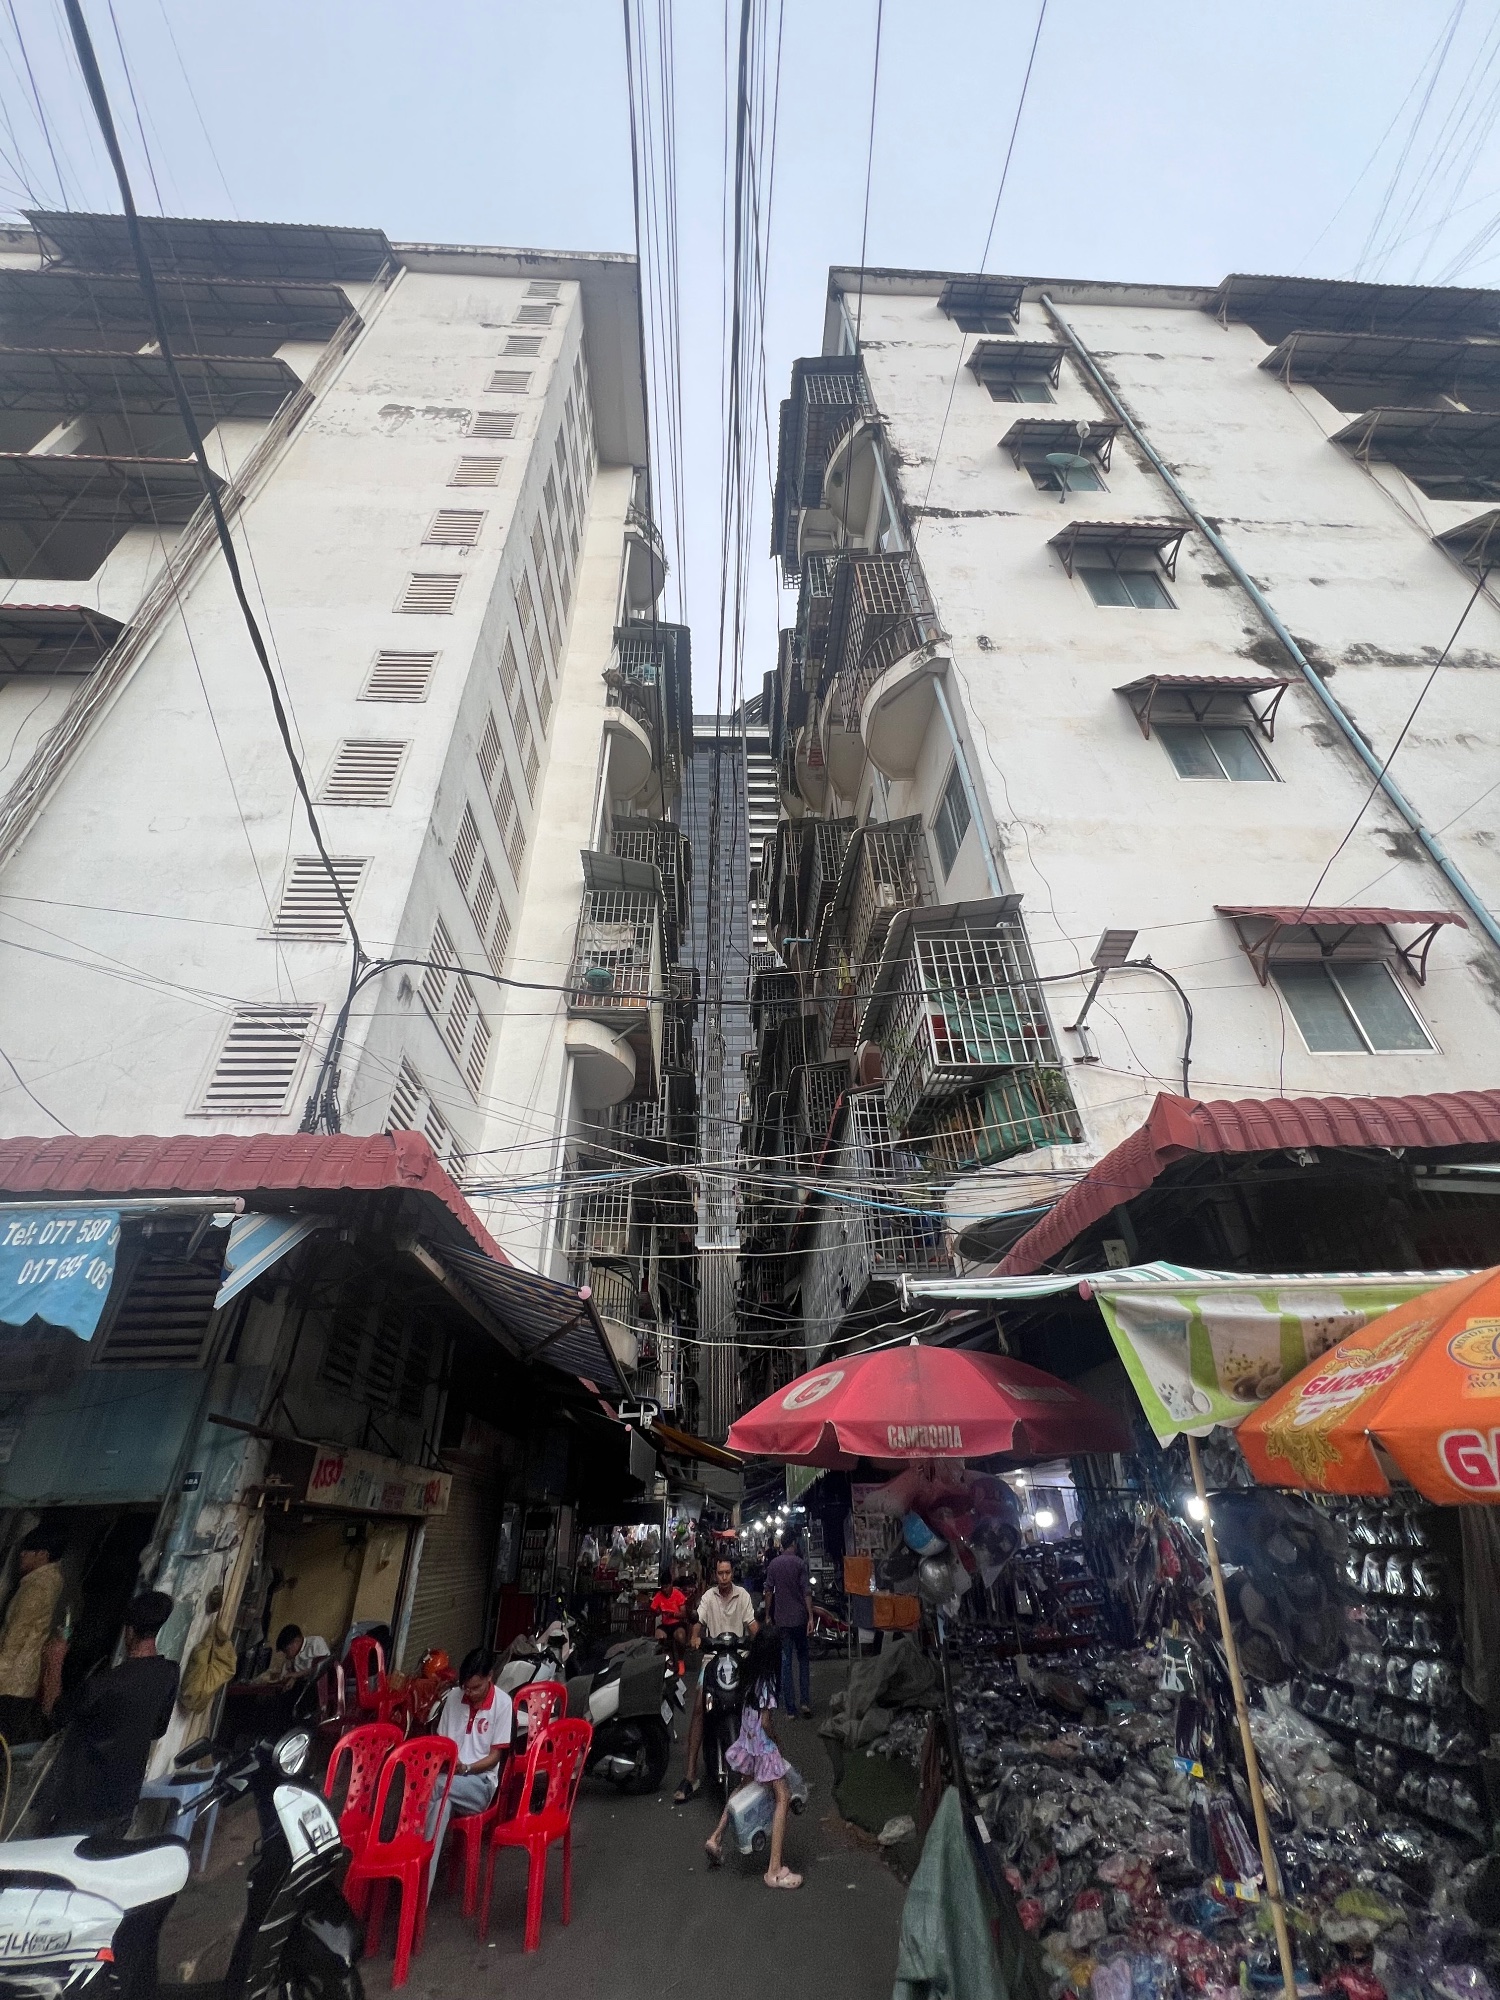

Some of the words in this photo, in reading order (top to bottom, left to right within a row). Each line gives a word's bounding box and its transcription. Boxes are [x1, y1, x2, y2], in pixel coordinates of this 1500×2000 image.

[1, 1222, 38, 1246] Tel:
[38, 1219, 78, 1245] 077
[76, 1218, 112, 1244] 580
[17, 1258, 59, 1285] 017
[85, 1256, 113, 1290] 105
[886, 1424, 963, 1450] CAMBODIA
[1439, 1429, 1500, 1491] G
